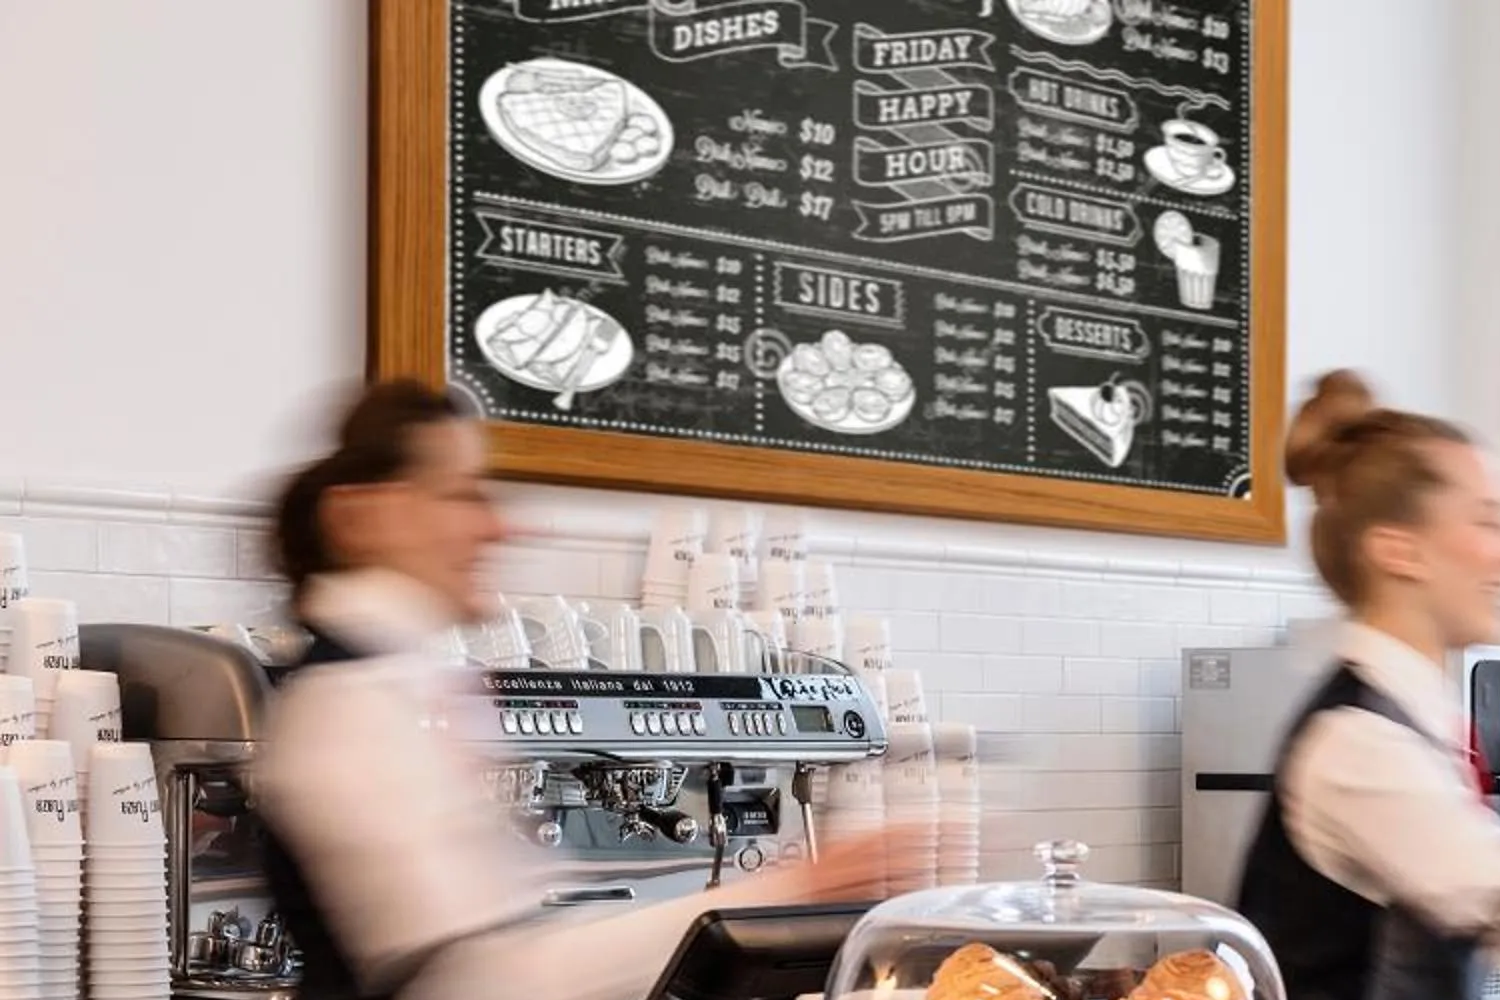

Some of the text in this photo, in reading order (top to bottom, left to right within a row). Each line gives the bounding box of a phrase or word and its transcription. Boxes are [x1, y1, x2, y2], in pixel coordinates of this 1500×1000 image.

[673, 10, 780, 51] DISHES
[872, 35, 973, 67] FRIDAY
[878, 91, 973, 123] HAPPY
[1028, 78, 1119, 118] HOT DRINKS
[800, 116, 836, 145] $10
[800, 154, 835, 182] $12
[885, 146, 965, 178] HOUR
[800, 191, 835, 221] $17
[1026, 191, 1123, 231] COLD DRINKS
[500, 226, 601, 266] STARTERS
[799, 272, 881, 314] SIDES
[1055, 315, 1132, 352] DESSERTS
